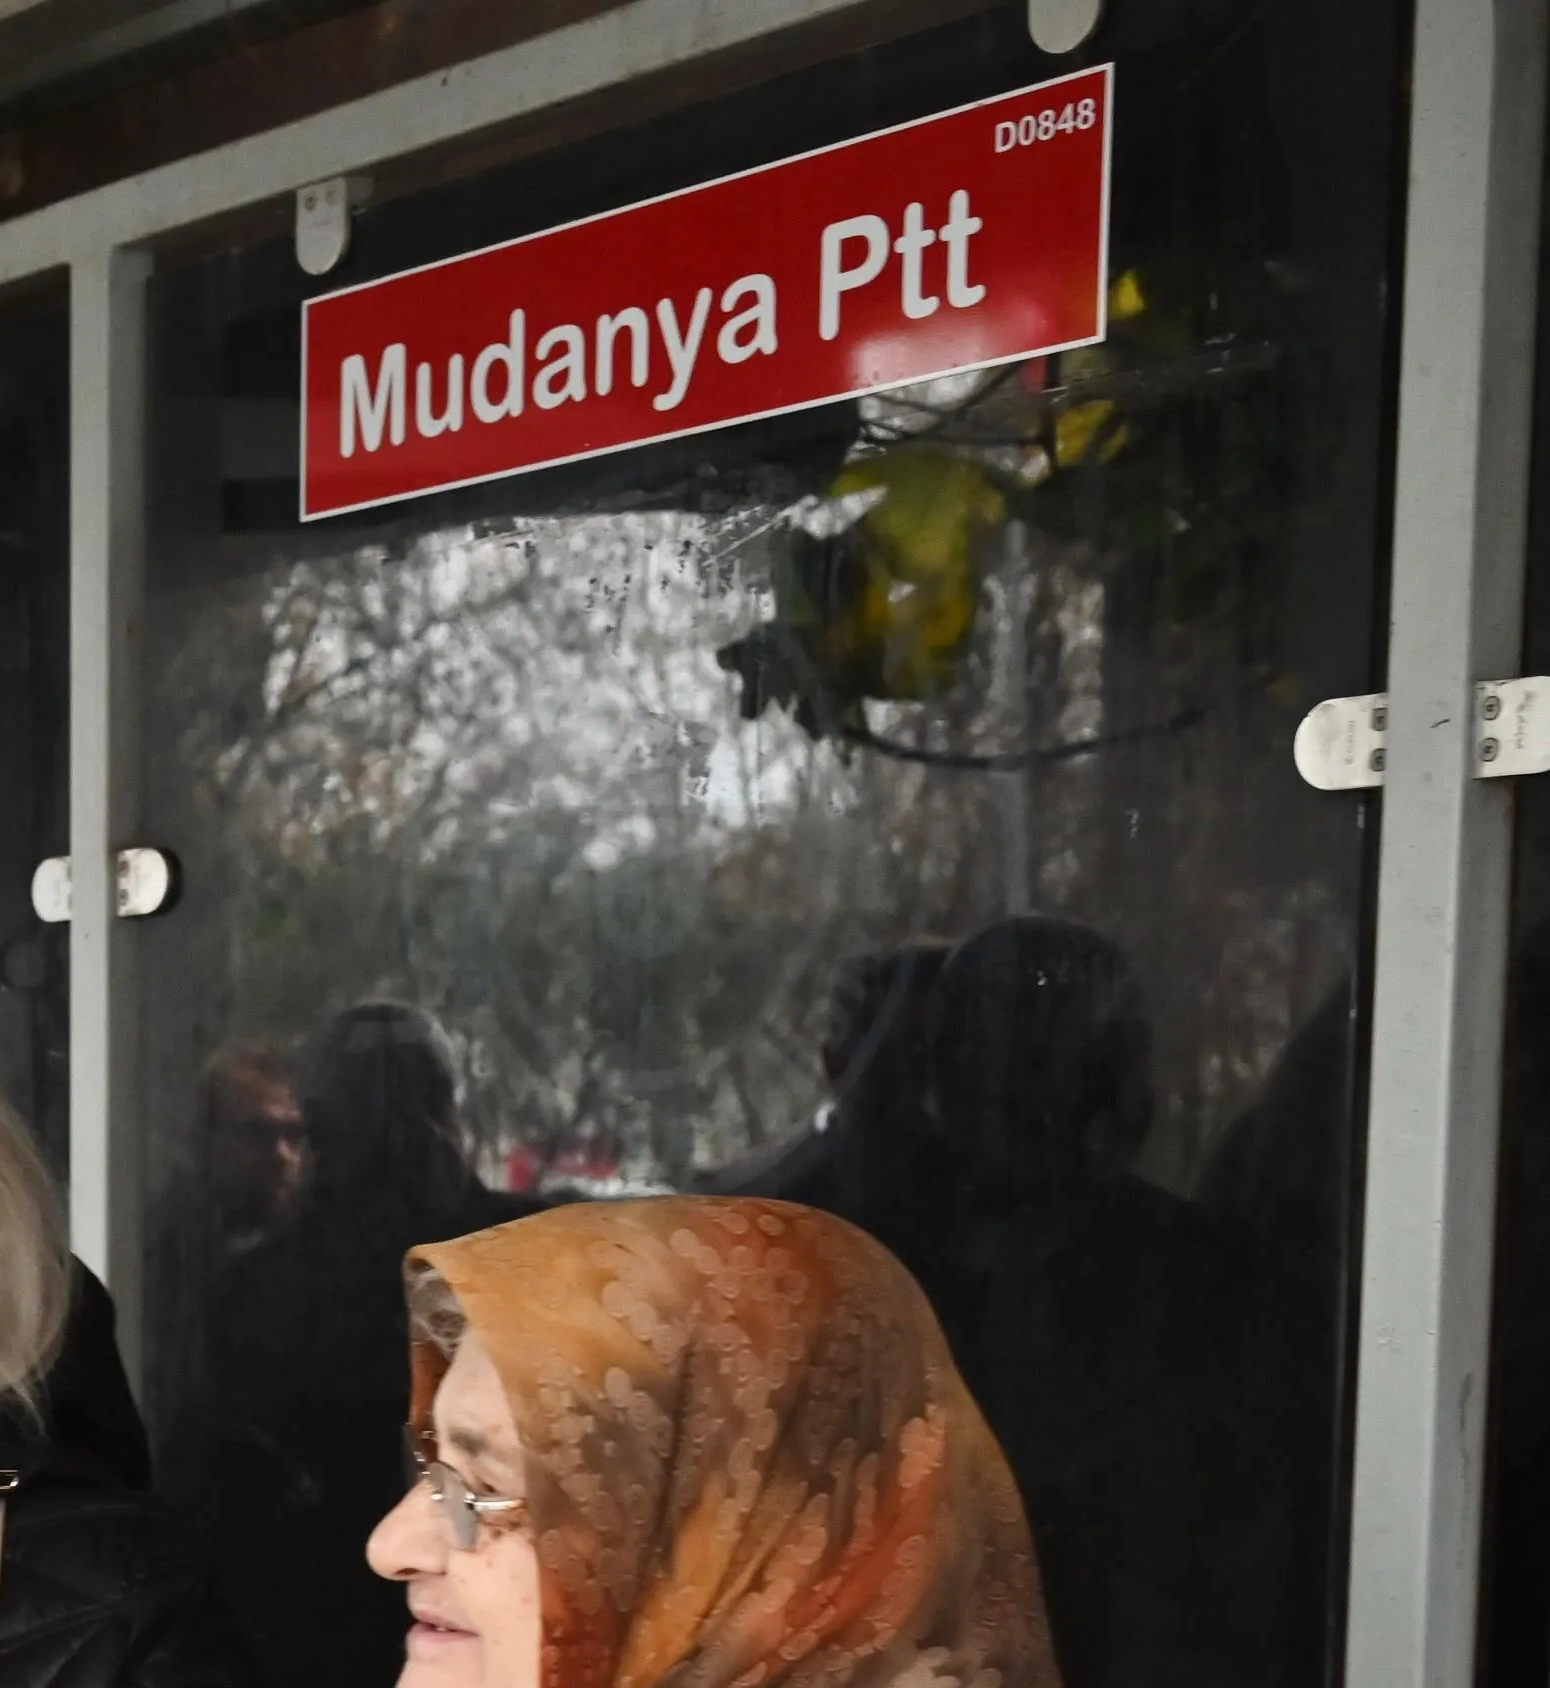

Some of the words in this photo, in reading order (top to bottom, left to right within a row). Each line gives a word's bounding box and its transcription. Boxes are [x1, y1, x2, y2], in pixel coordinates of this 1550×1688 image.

[993, 97, 1097, 154] D0848
[339, 272, 777, 459] Mudanya
[818, 188, 987, 341] Ptt
